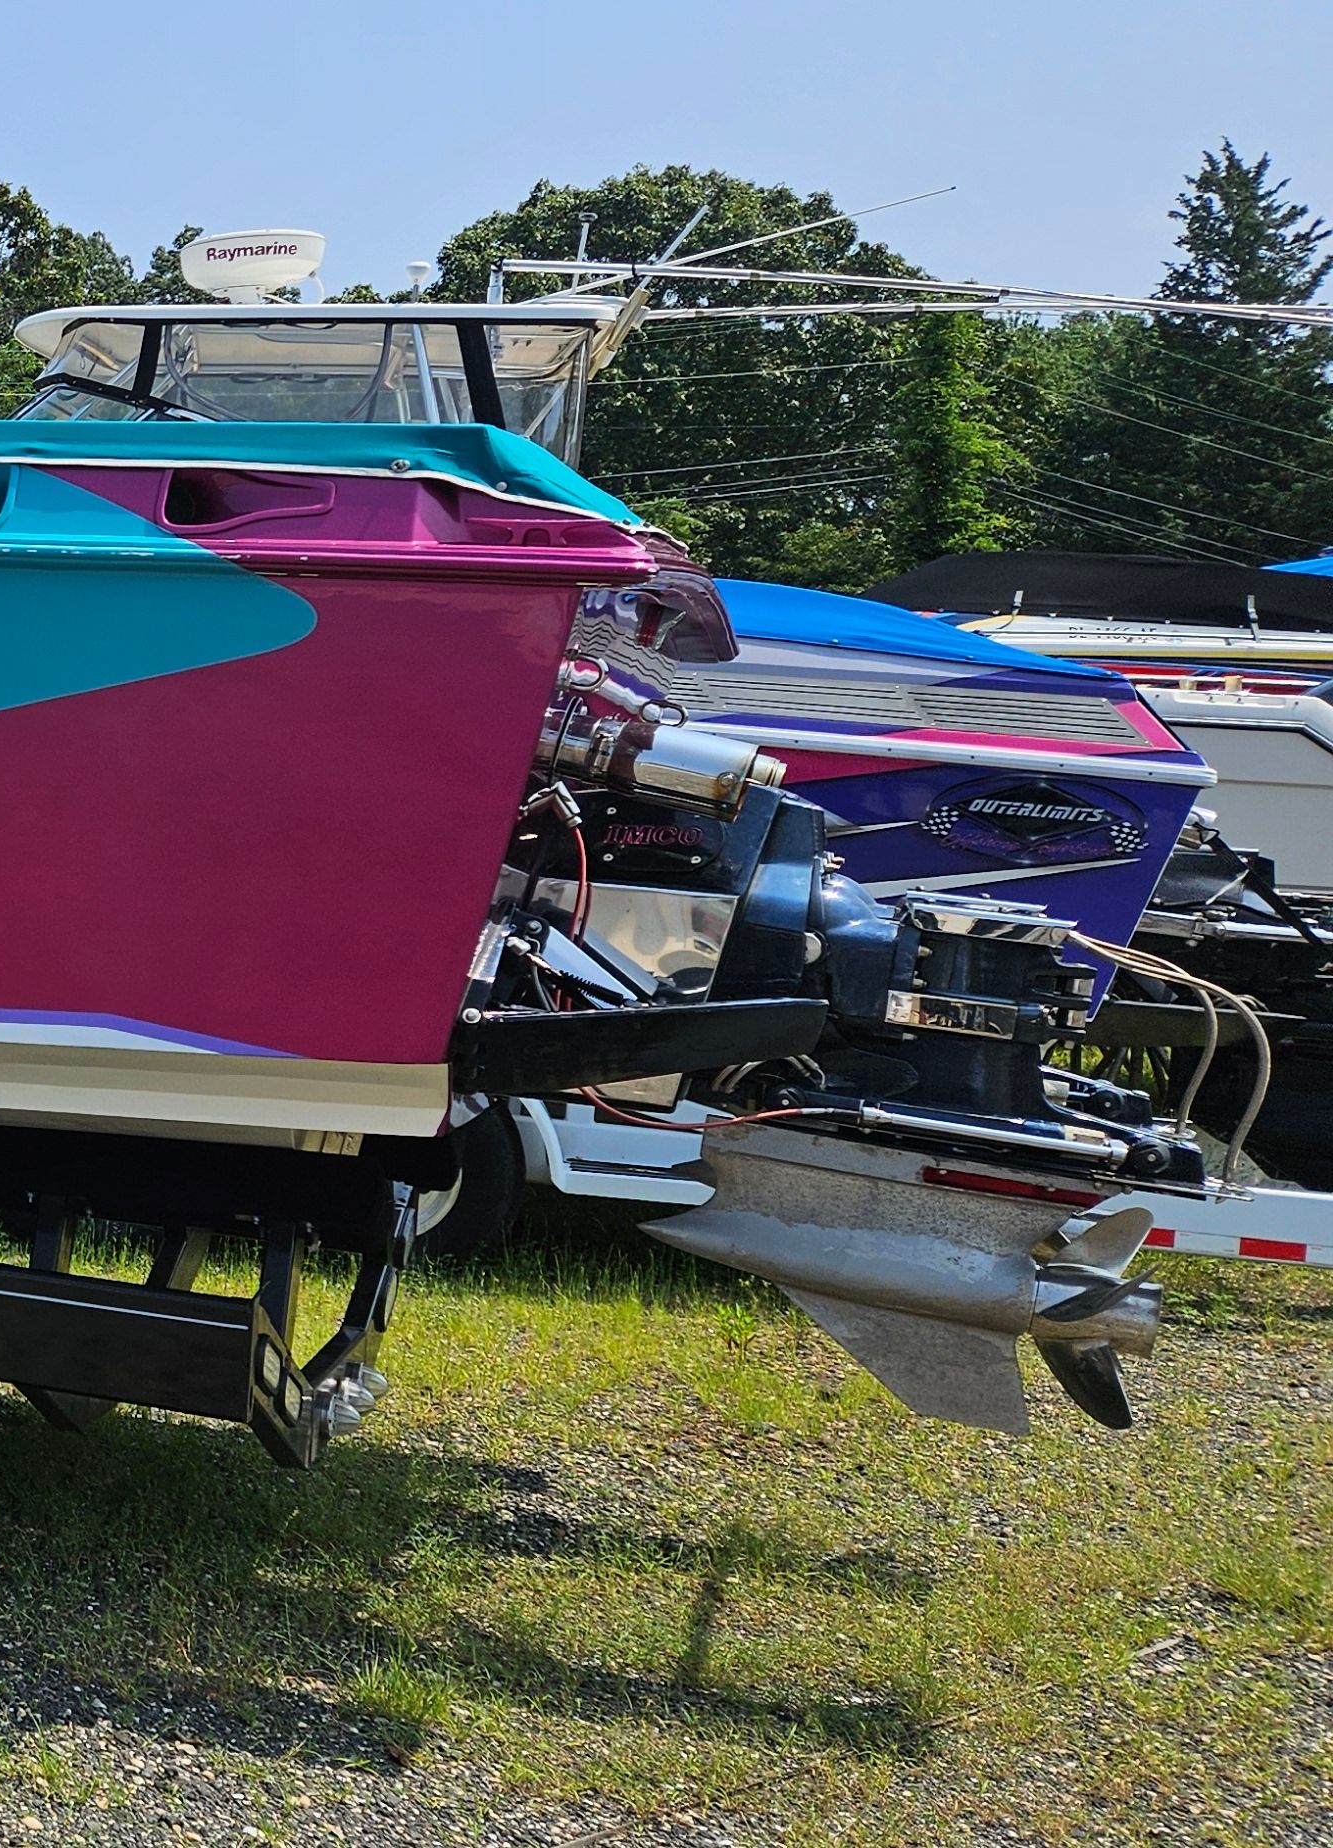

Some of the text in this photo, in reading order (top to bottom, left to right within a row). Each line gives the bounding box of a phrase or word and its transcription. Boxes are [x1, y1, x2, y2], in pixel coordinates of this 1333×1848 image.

[206, 241, 298, 261] Raymarine
[968, 799, 1105, 822] OUTERLIMITS
[603, 824, 704, 846] IMCO
